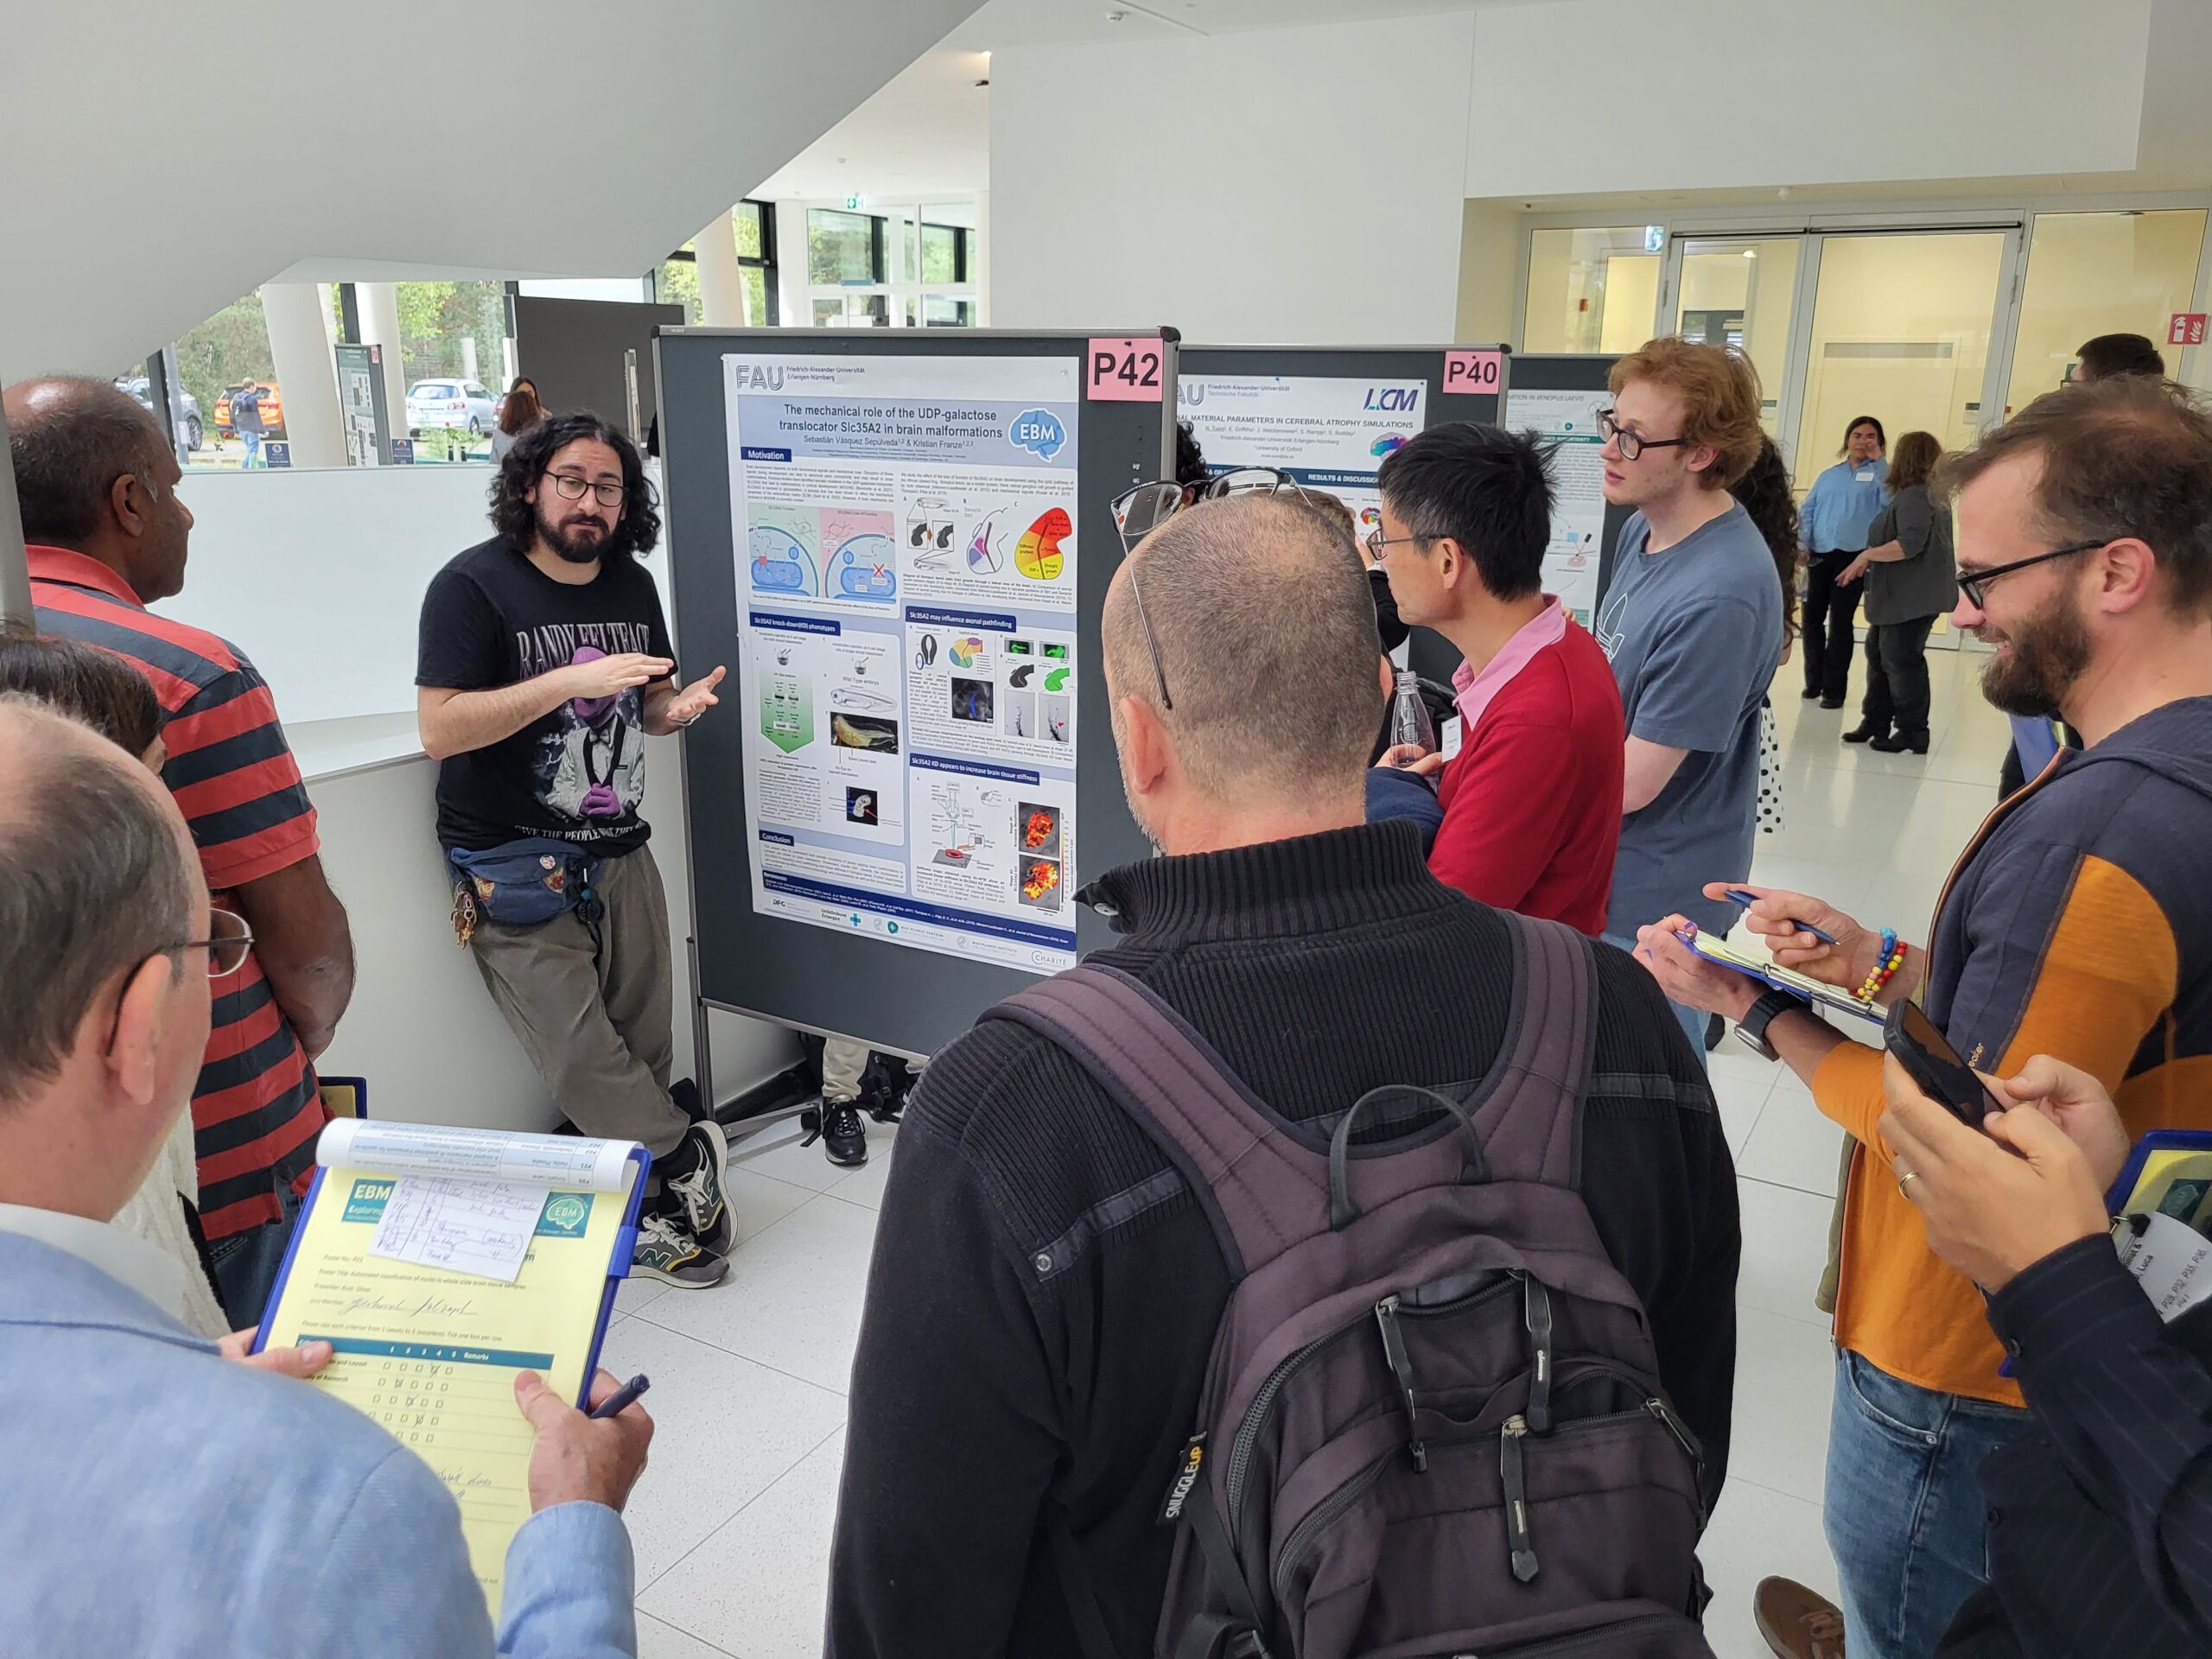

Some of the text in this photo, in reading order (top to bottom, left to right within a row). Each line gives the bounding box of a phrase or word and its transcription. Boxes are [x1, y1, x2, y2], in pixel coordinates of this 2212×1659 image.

[736, 365, 784, 391] FAU
[1094, 353, 1159, 386] P42
[1448, 361, 1497, 384] P40
[785, 404, 997, 422] The mechanical role of the UDP-galactose
[779, 421, 1003, 438] translocator Slc35A2 in brain malformations
[1227, 416, 1274, 424] PARAMETERS
[1285, 417, 1325, 426] CEREBRAL
[1326, 419, 1361, 428] ATROPHY
[1363, 420, 1414, 429] SIMULATIONS
[836, 436, 862, 446] Vásquez
[1020, 423, 1055, 442] EBM
[747, 450, 785, 461] Motivation
[754, 617, 772, 626] Slc35A2
[910, 612, 930, 620] Slc35A2
[942, 615, 964, 624] influence
[982, 619, 1013, 629] pathfinding
[516, 624, 576, 681] RANDY
[912, 758, 931, 766] Slc35A2
[939, 762, 960, 771] appears
[966, 765, 986, 774] increase
[987, 767, 1000, 776] brain
[1001, 770, 1016, 779] tissue
[1016, 772, 1038, 782] stiffness
[565, 829, 601, 842] PEOPLE
[762, 833, 791, 844] Conclusion
[1032, 950, 1066, 967] CHARITÉ
[1967, 1042, 1984, 1067] eaker
[353, 1184, 392, 1200] EBM
[555, 1206, 577, 1217] EBM
